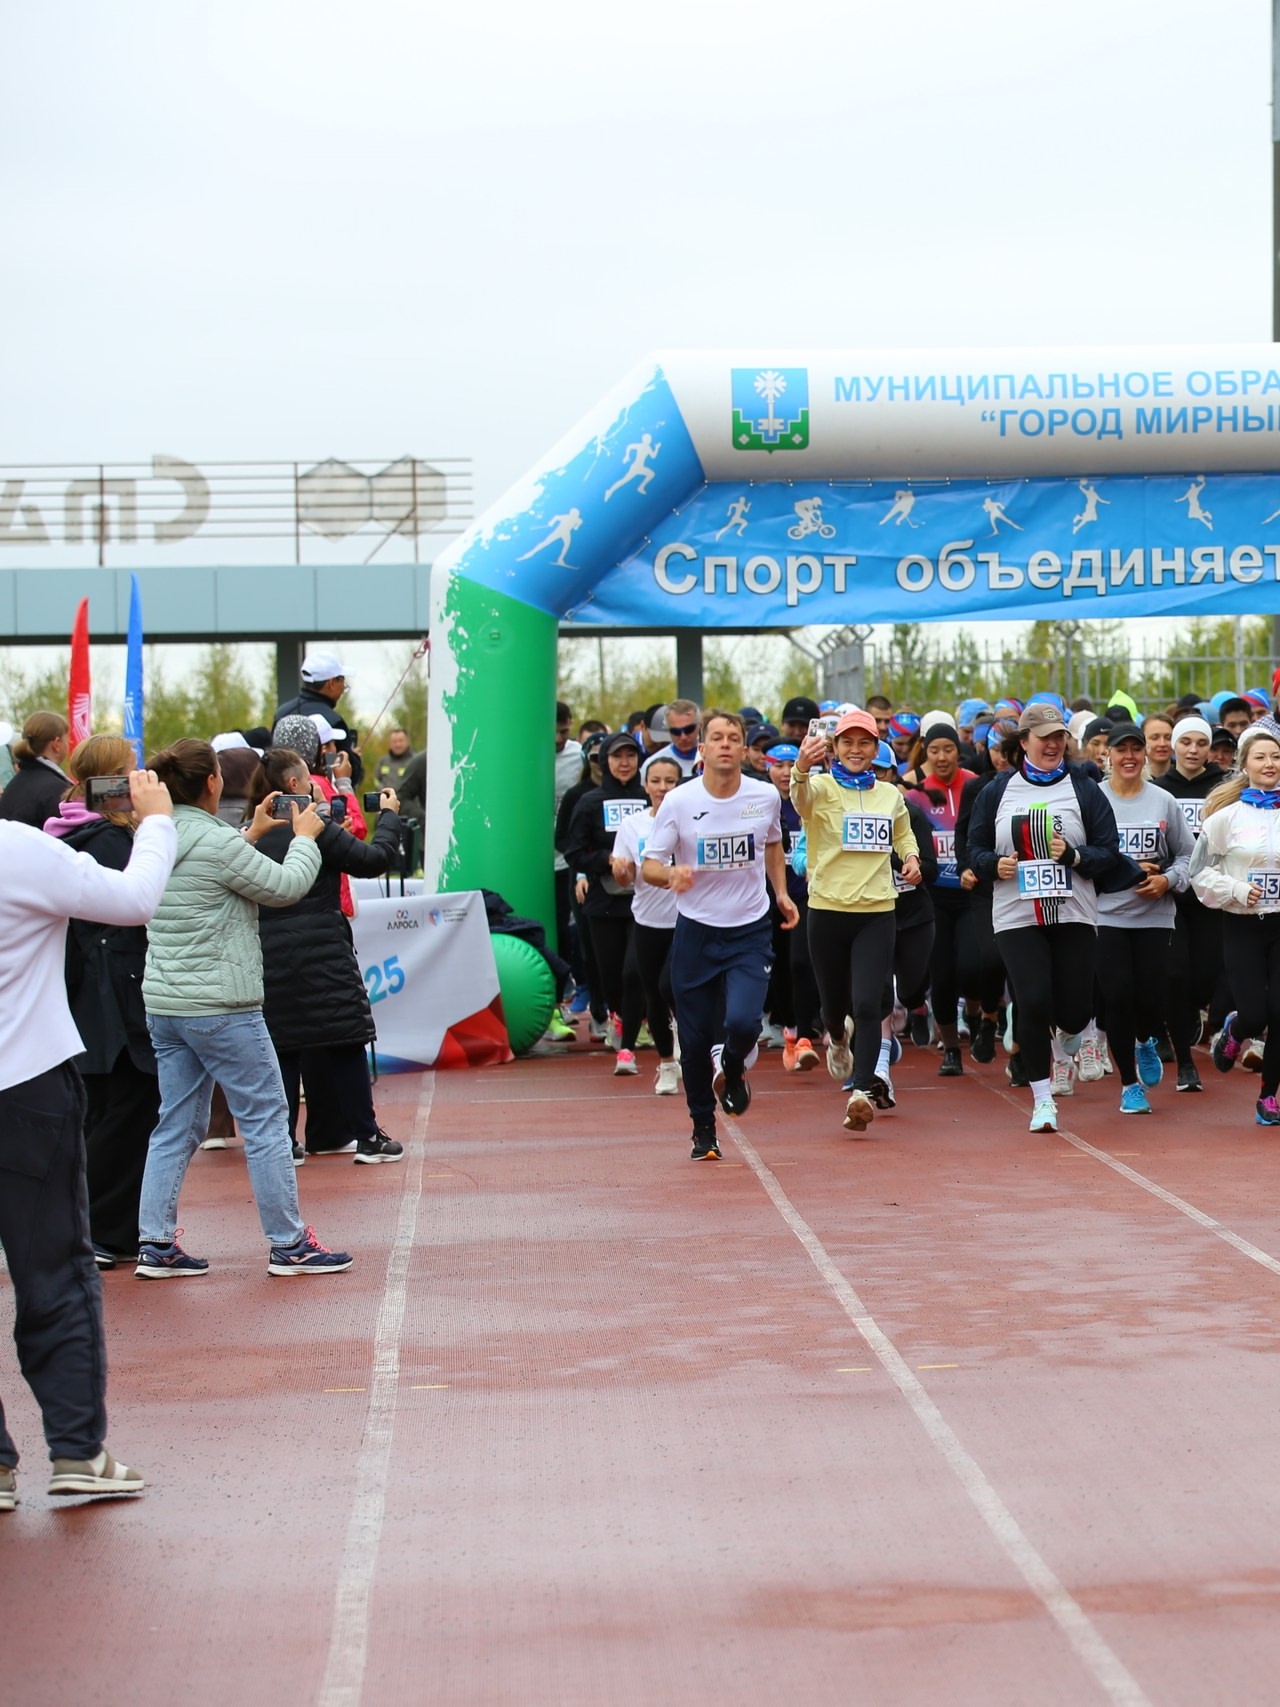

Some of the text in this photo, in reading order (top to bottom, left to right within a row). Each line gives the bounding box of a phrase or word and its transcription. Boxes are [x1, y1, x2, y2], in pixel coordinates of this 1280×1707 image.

[835, 371, 1173, 404] МУНИЦИПАЛЬНОЕ
[653, 542, 857, 607] Спорт
[848, 822, 888, 841] 336
[706, 840, 748, 860] 314
[1026, 868, 1066, 888] 351
